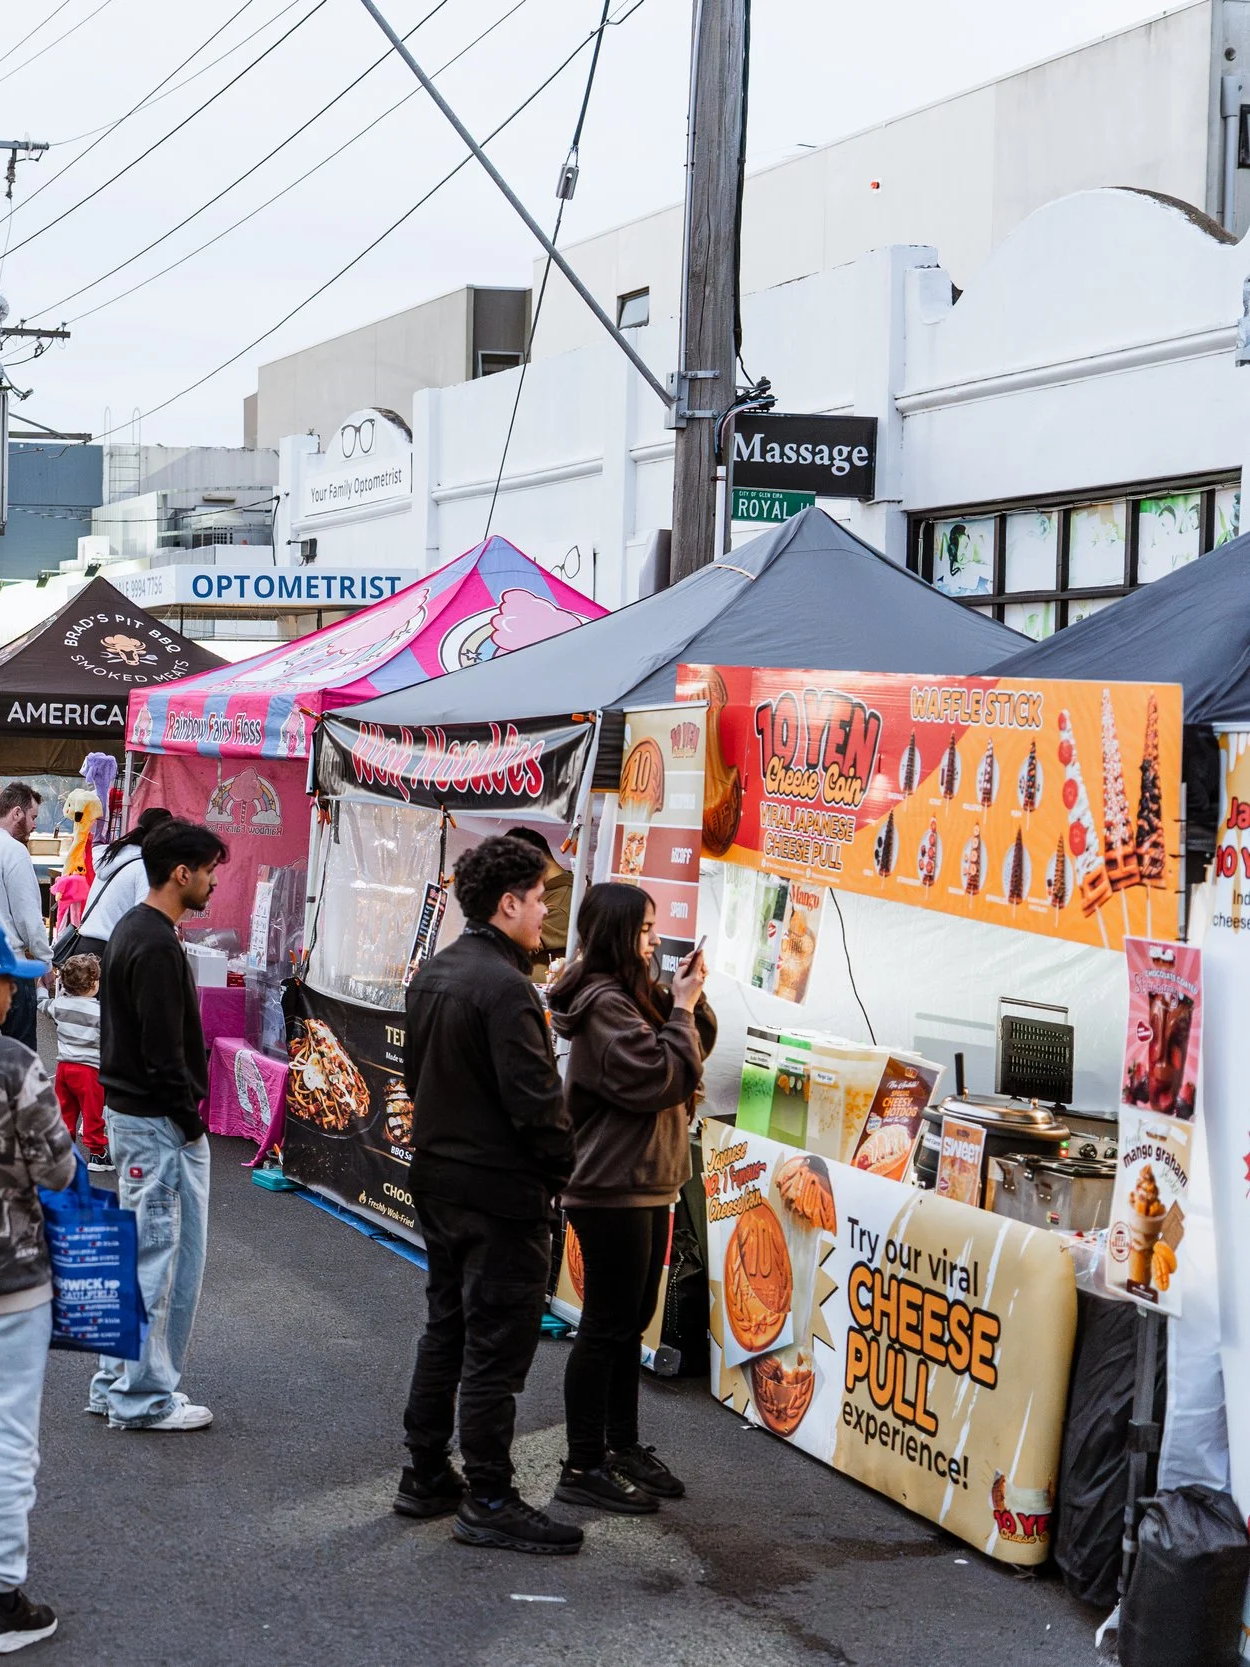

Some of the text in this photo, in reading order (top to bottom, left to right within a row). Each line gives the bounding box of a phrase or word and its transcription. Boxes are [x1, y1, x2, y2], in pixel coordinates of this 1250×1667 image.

[734, 432, 869, 476] Massage
[311, 467, 403, 503] Your Family Optometrist
[738, 499, 793, 520] ROYAL
[192, 574, 401, 599] OPTOMETRIST
[64, 613, 182, 655] BRAD'S PIT BBQ
[70, 653, 190, 683] SMOKED MEATS
[7, 701, 128, 726] AMERICA
[911, 687, 1044, 729] WAFFLE STICK
[165, 710, 263, 747] Rainbow Fairy Floss
[755, 687, 882, 782] 10 YEN
[351, 722, 546, 803] Wok Noodles
[764, 754, 821, 801] Cheese
[822, 761, 865, 808] Coin
[760, 802, 855, 843] VIRAL JAPANESE
[764, 833, 843, 872] CHEESE PULL
[789, 884, 820, 911] Mango
[882, 1097, 913, 1107] CHEESY
[883, 1106, 919, 1117] HOTDOG
[390, 1145, 404, 1159] BBQ
[1123, 1143, 1188, 1187] mango graham
[368, 1197, 415, 1228] Freshly Wok-Fried
[383, 1182, 415, 1209] CHOO
[847, 1217, 979, 1297] Try our viral
[848, 1260, 1001, 1389] CHEESE
[845, 1325, 939, 1437] PULL
[842, 1399, 970, 1490] experience!
